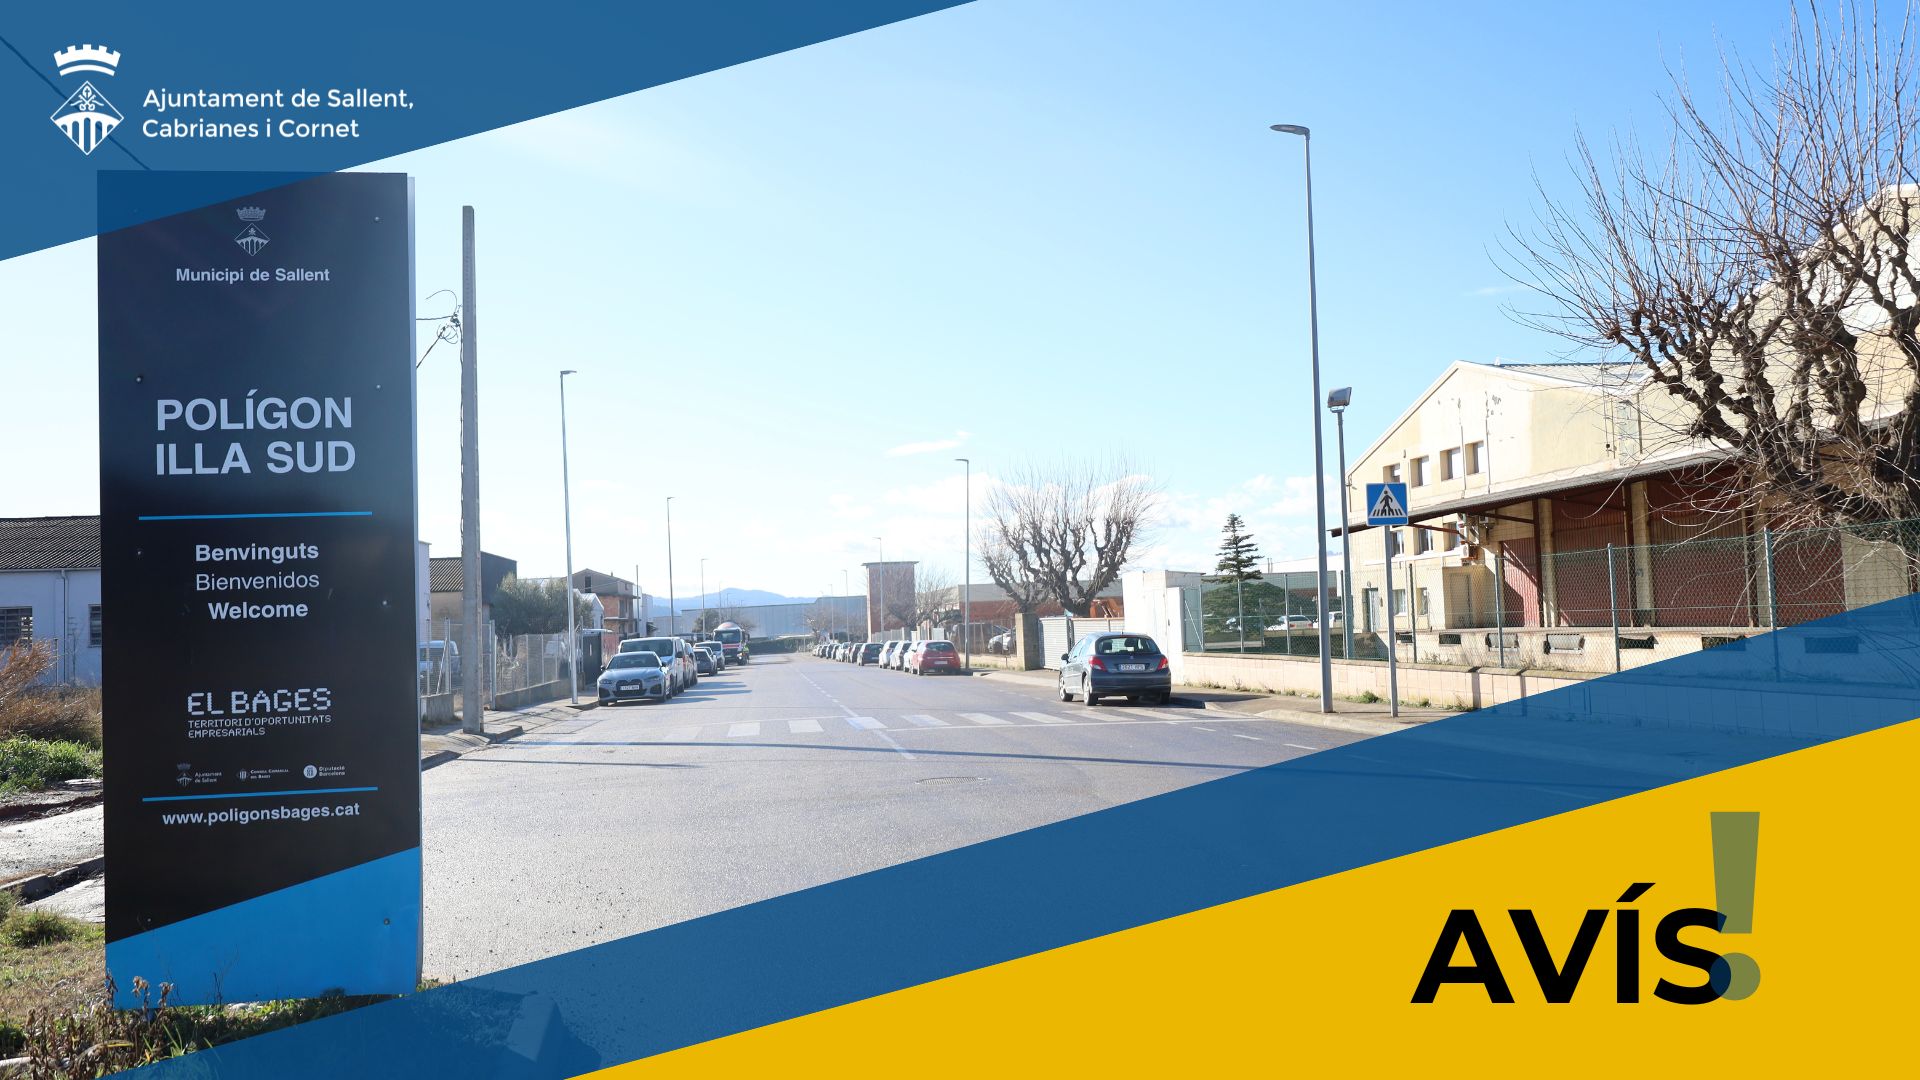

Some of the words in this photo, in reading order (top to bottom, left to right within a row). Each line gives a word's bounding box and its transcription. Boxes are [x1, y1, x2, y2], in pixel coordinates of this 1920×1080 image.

[176, 268, 244, 284] Municipi
[250, 269, 270, 282] de
[276, 268, 330, 282] Sallent
[157, 389, 352, 431] POLÍGON
[156, 442, 251, 475] ILLA
[267, 441, 356, 474] SUD
[195, 542, 319, 564] Benvinguts
[196, 571, 320, 591] Bienvenidos
[208, 601, 309, 620] Welcome
[188, 692, 224, 716] EL
[231, 687, 332, 714] BAGES
[188, 718, 243, 729] TERRITORI
[188, 727, 266, 739] EMPRESARIALS
[162, 803, 360, 826] www.poligonsbages.cat
